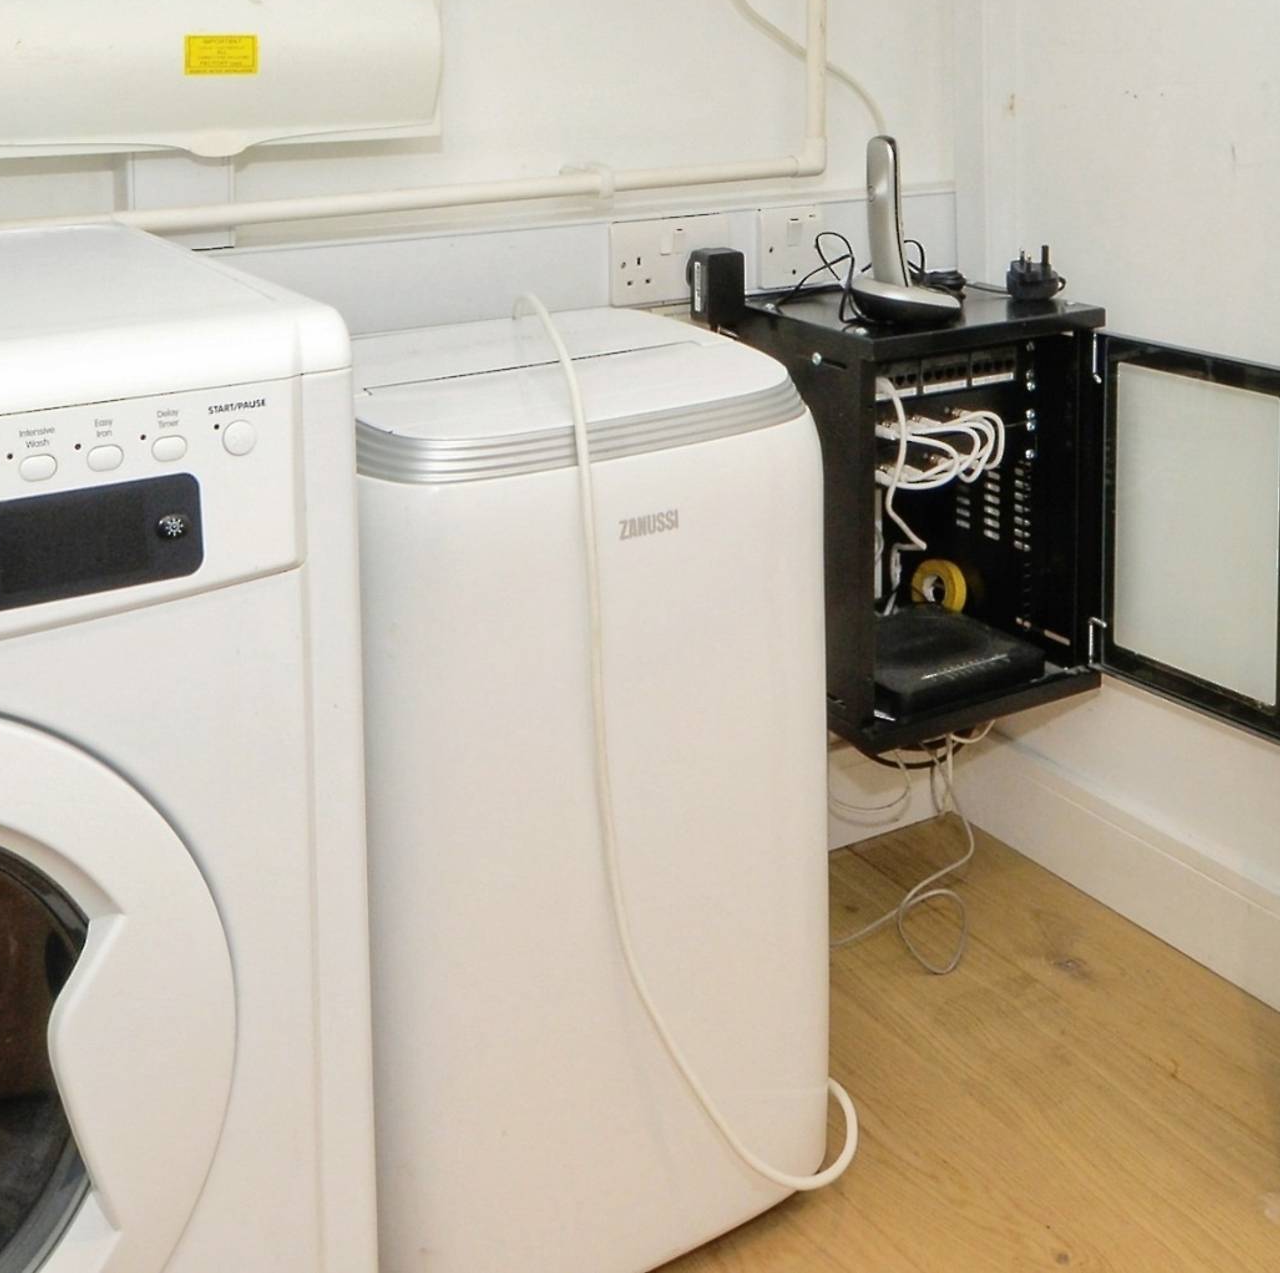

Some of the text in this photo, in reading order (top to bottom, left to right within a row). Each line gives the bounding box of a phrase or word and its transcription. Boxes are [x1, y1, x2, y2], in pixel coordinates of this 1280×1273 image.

[208, 399, 267, 415] START/PAUSE
[156, 409, 179, 419] Delay
[19, 426, 56, 438] Intensive
[25, 438, 50, 449] Wash
[618, 508, 679, 540] ZANUSSI
